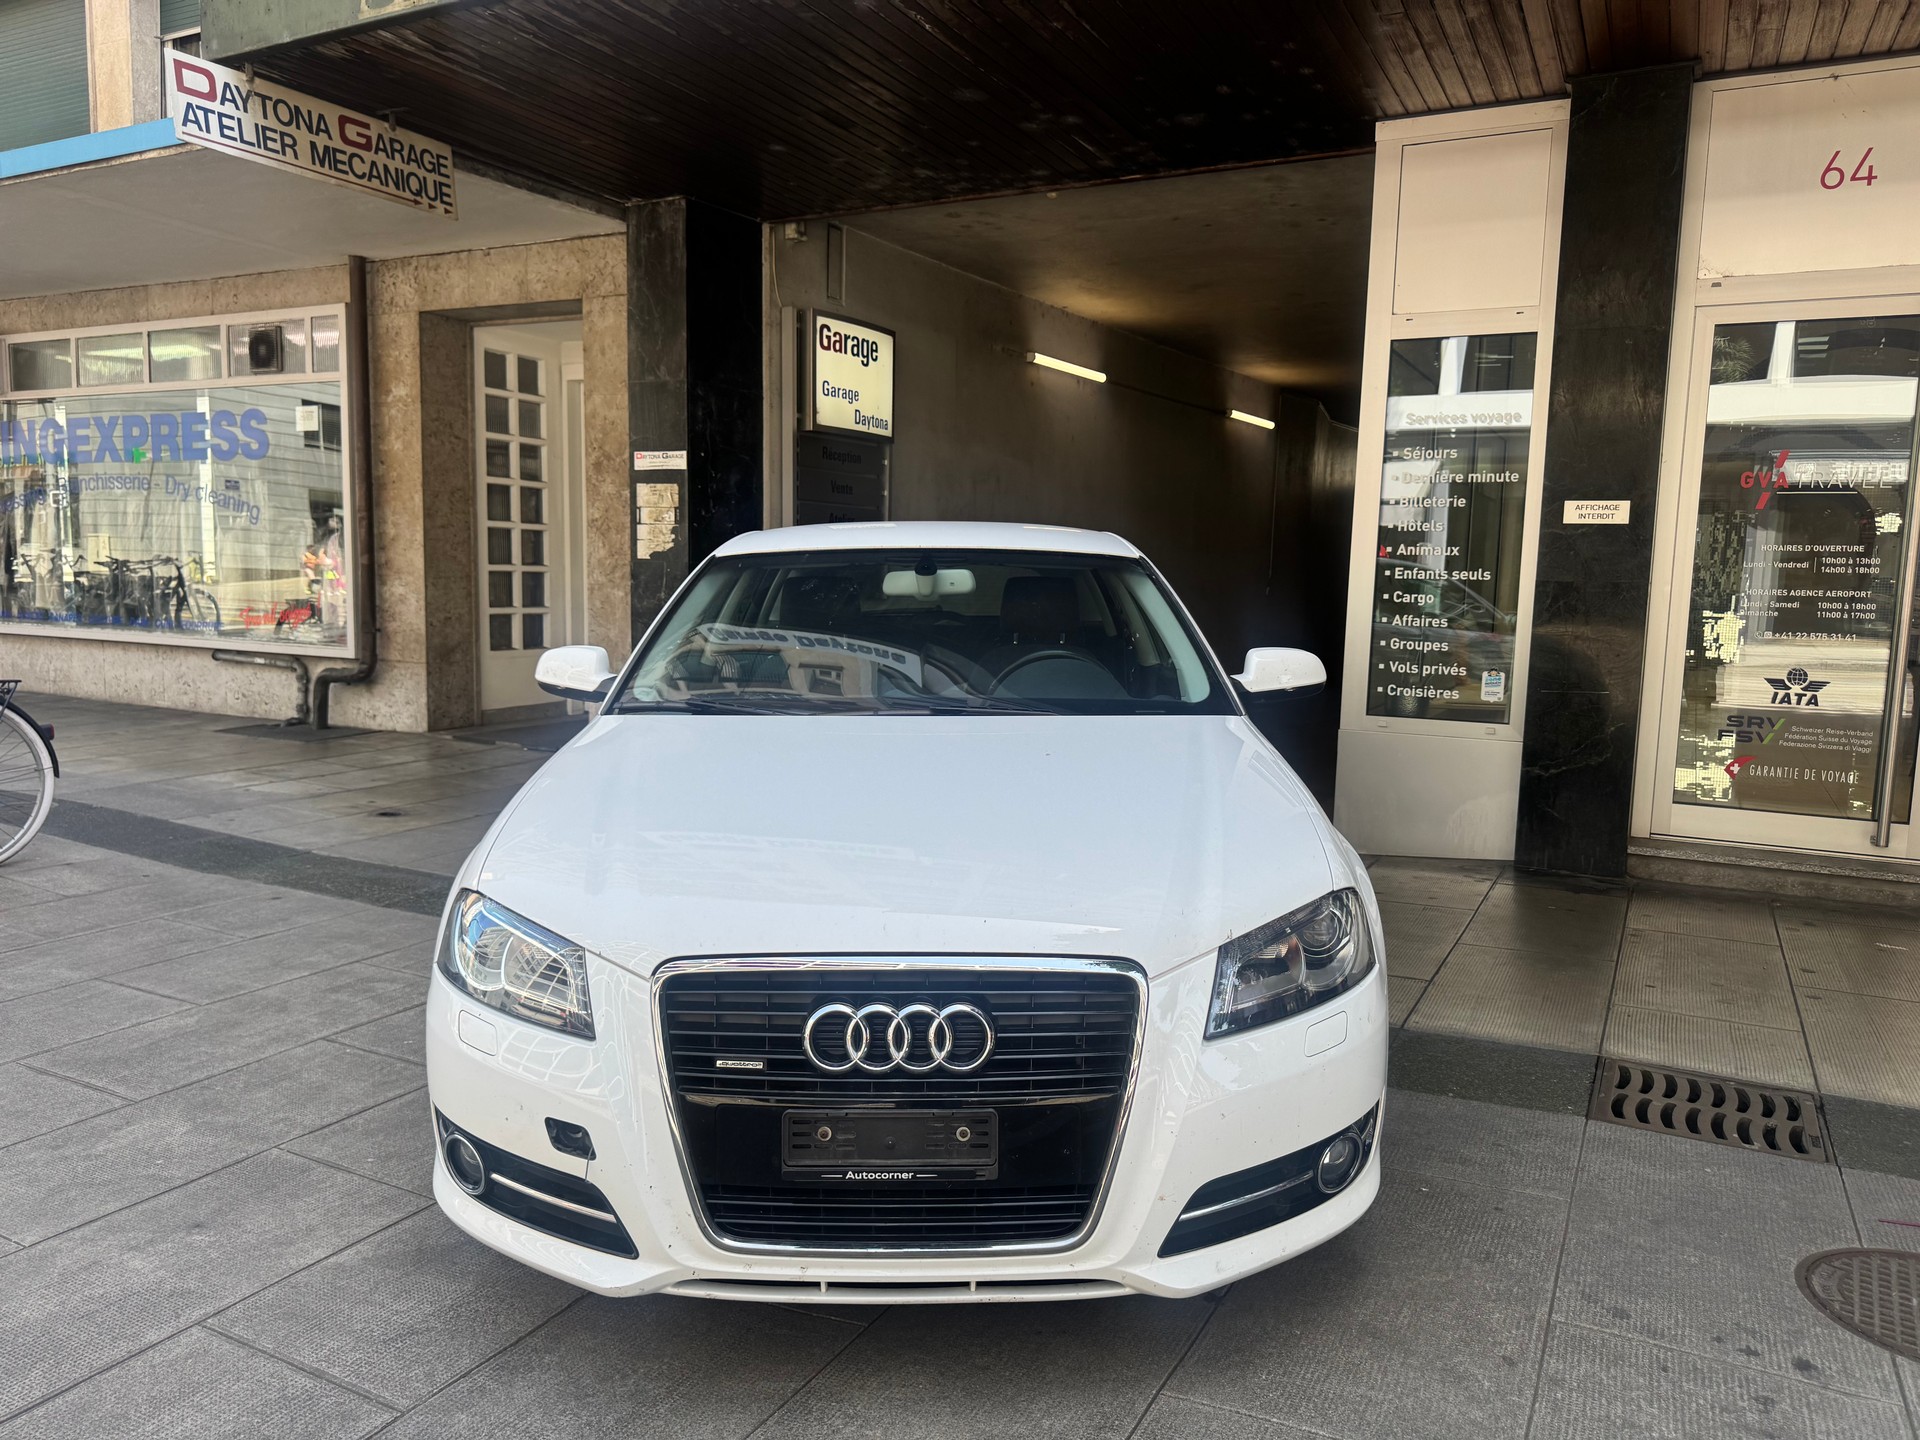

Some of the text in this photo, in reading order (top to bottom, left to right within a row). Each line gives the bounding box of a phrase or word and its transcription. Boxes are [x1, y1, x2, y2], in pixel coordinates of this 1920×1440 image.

[173, 58, 451, 180] DAYTONA GARAGE
[181, 101, 454, 207] ATELIER MECANIQUE
[1820, 146, 1878, 190] 64
[818, 323, 879, 367] Garage
[822, 380, 860, 404] Garage
[854, 409, 889, 431] Daytona
[1406, 411, 1522, 426] Services voyage
[1402, 446, 1458, 461] Séjours
[1401, 469, 1520, 484] Dernière minute
[1740, 471, 1789, 489] GVA
[165, 474, 191, 502] Dry
[195, 483, 261, 525] cleaning
[1399, 495, 1467, 508] Billeterie
[1397, 519, 1444, 532] Hôtels
[1396, 543, 1460, 556] Animaux
[1805, 545, 1865, 553] D'OUVERTURE
[1773, 561, 1810, 569] Vendredi
[1856, 557, 1881, 565] 13h00
[1394, 567, 1491, 581] Enfants seuls
[1821, 566, 1846, 574] 14h00
[1855, 566, 1880, 574] 18h00
[1393, 591, 1435, 605] Cargo
[1746, 588, 1873, 598] HORAIRES AGENCE AEROPORT
[1740, 600, 1763, 608] Lundi
[1769, 601, 1800, 609] Samedi
[1852, 602, 1877, 610] 18h00
[1391, 614, 1449, 628] Affaires
[1817, 611, 1842, 619] 11h00
[1775, 632, 1793, 640] +41
[1795, 632, 1807, 640] 22
[1830, 633, 1841, 641] 31
[1844, 633, 1857, 641] 41
[1389, 638, 1449, 653] Groupes
[1389, 660, 1467, 676] Vols privés
[1387, 684, 1460, 699] Croisières
[1770, 691, 1820, 707] IATA
[1726, 714, 1786, 731] SRV
[1717, 729, 1775, 745] FSV
[1791, 725, 1874, 737] Schweizer Reise-Verband
[1784, 732, 1817, 741] Fédération
[1818, 734, 1839, 743] Suisse
[1849, 737, 1873, 745] Voyage
[1779, 740, 1817, 748] Federazione
[1818, 742, 1844, 750] Svizzera
[1851, 745, 1872, 753] Viaggi
[1749, 764, 1860, 784] GARANTIE DE VOYAGE
[845, 1169, 915, 1180] Autocorner
